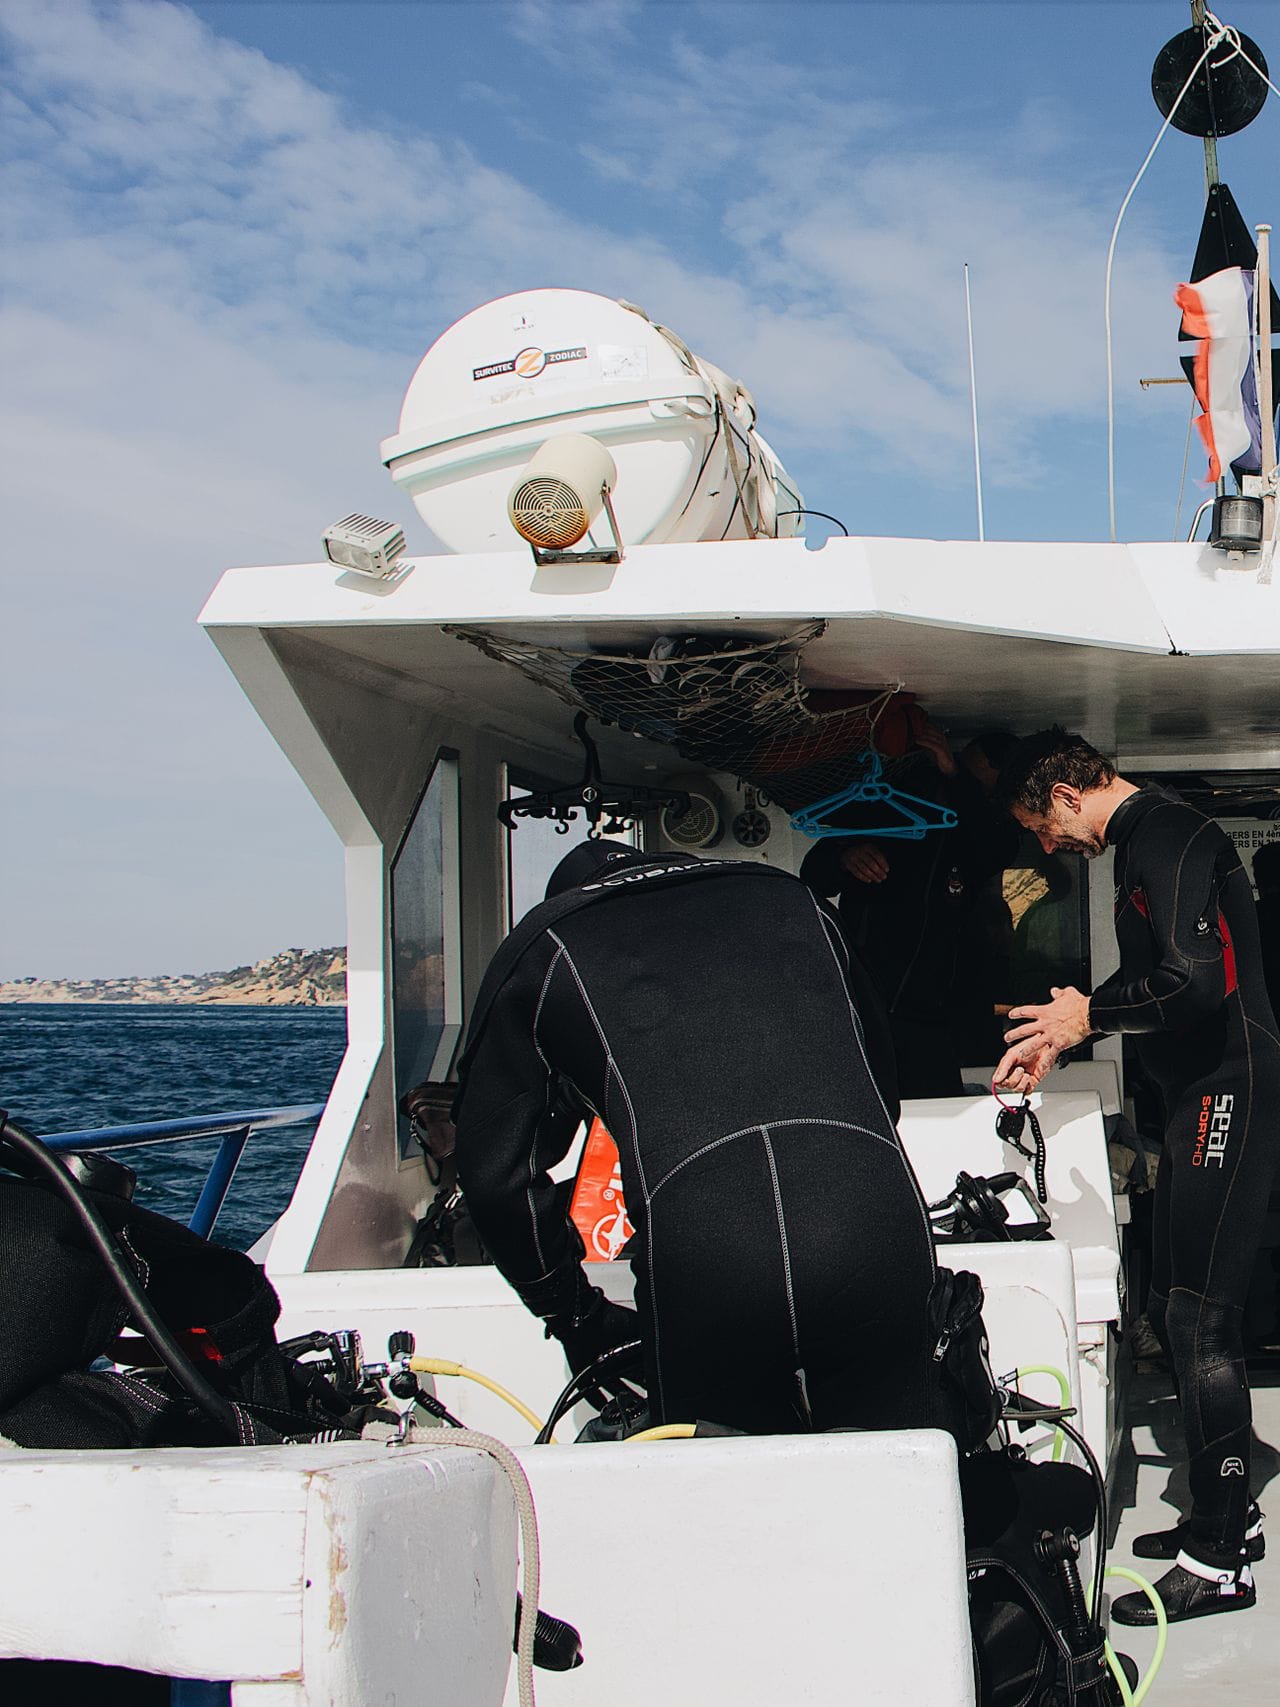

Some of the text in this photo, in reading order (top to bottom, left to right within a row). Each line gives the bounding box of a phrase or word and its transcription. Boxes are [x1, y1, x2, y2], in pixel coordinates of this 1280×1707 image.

[474, 362, 514, 379] SURVITEC
[550, 351, 582, 362] ZODIAC
[1252, 830, 1264, 839] EN
[1233, 840, 1250, 848] ERS
[1204, 1094, 1234, 1169] seac
